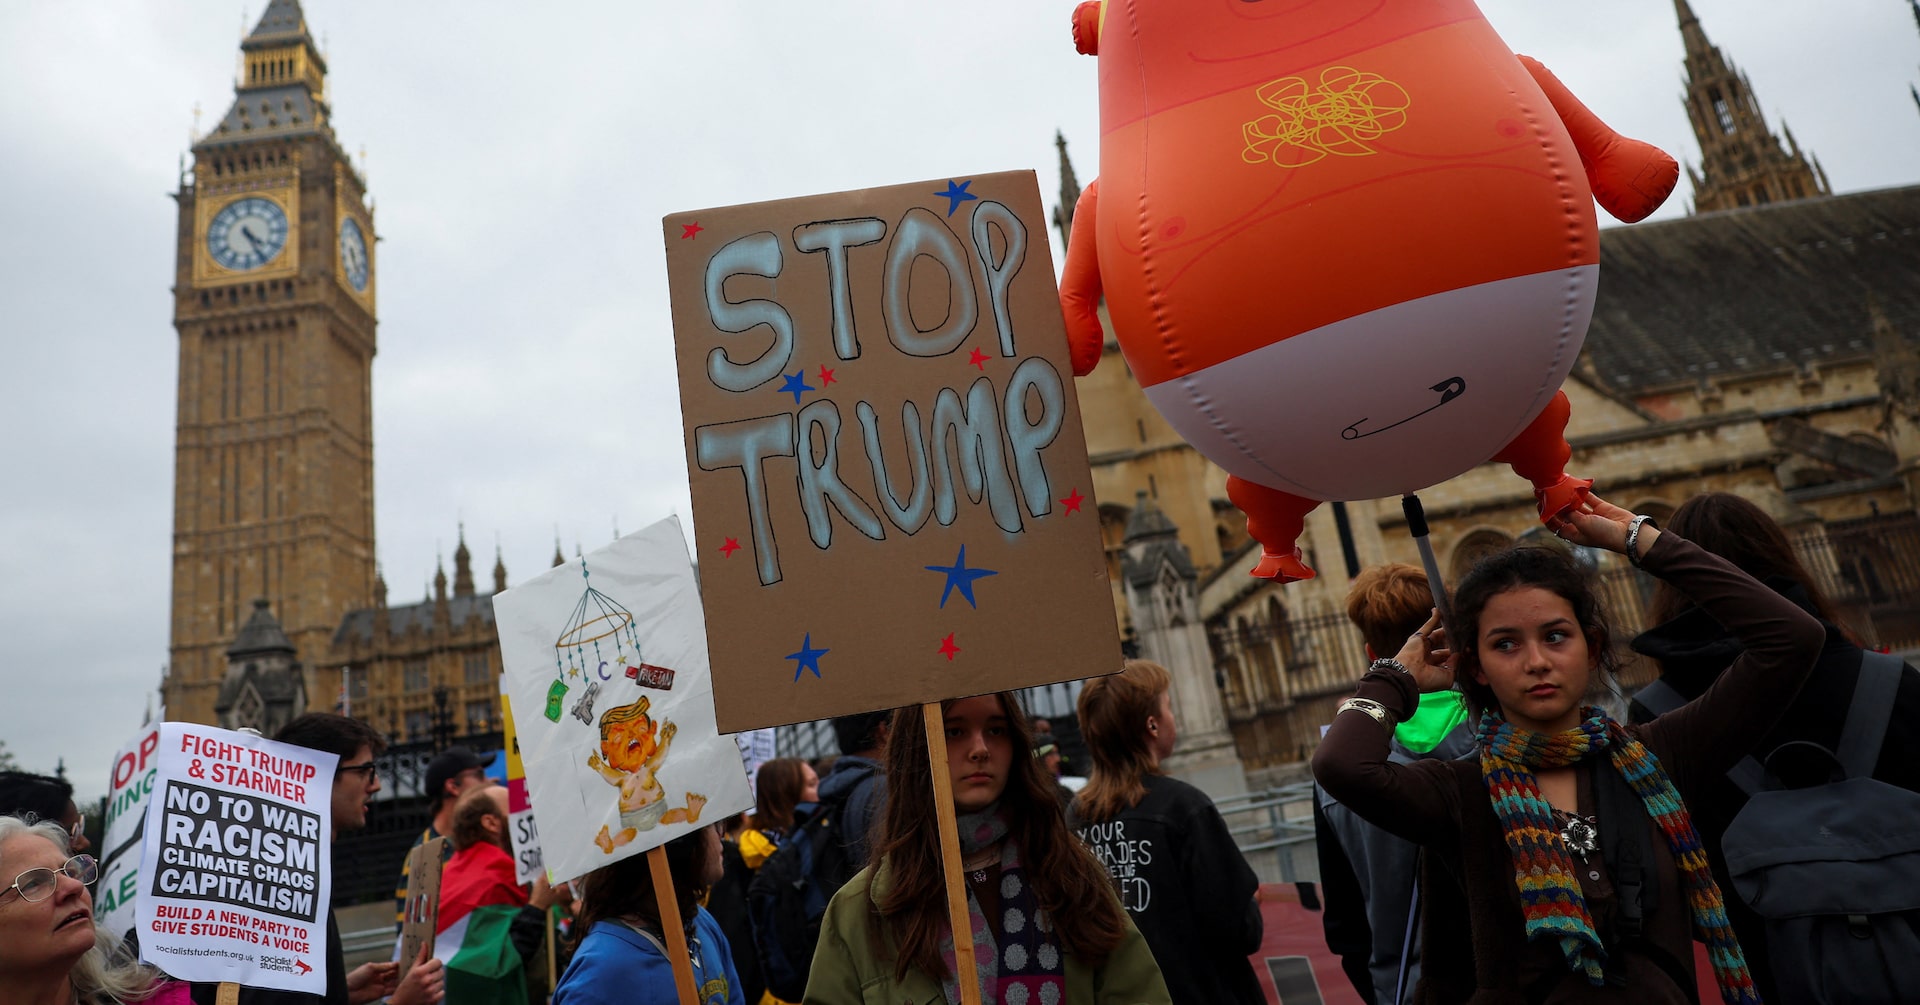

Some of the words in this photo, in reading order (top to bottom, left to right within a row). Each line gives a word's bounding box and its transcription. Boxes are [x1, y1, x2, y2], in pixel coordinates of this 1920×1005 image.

[705, 200, 1028, 392] STOP
[694, 356, 1066, 586] TRUMP
[114, 730, 158, 790] OP
[181, 733, 244, 763] FIGHT
[248, 749, 316, 784] TRUMP
[188, 758, 205, 780] &
[211, 763, 306, 804] STARMER
[167, 786, 211, 815] NO
[218, 796, 254, 823] TO
[261, 803, 319, 840] WAR
[165, 813, 316, 873] RACISM
[1091, 840, 1152, 865] RADES
[163, 847, 249, 877] CLIMATE
[253, 863, 315, 891] CHAOS
[1107, 864, 1136, 879] EING
[159, 868, 313, 917] CAPITALISM
[151, 920, 187, 935] GIVE
[190, 923, 259, 944] STUDENTS
[262, 934, 270, 947] A
[274, 936, 310, 954] VOICE
[156, 905, 202, 920] BUILD
[206, 909, 216, 921] A
[220, 911, 250, 927] NEW
[252, 918, 292, 936] PARTY
[293, 927, 308, 940] TO
[155, 945, 254, 963] socialiststudents.org.uk
[260, 961, 293, 973] students
